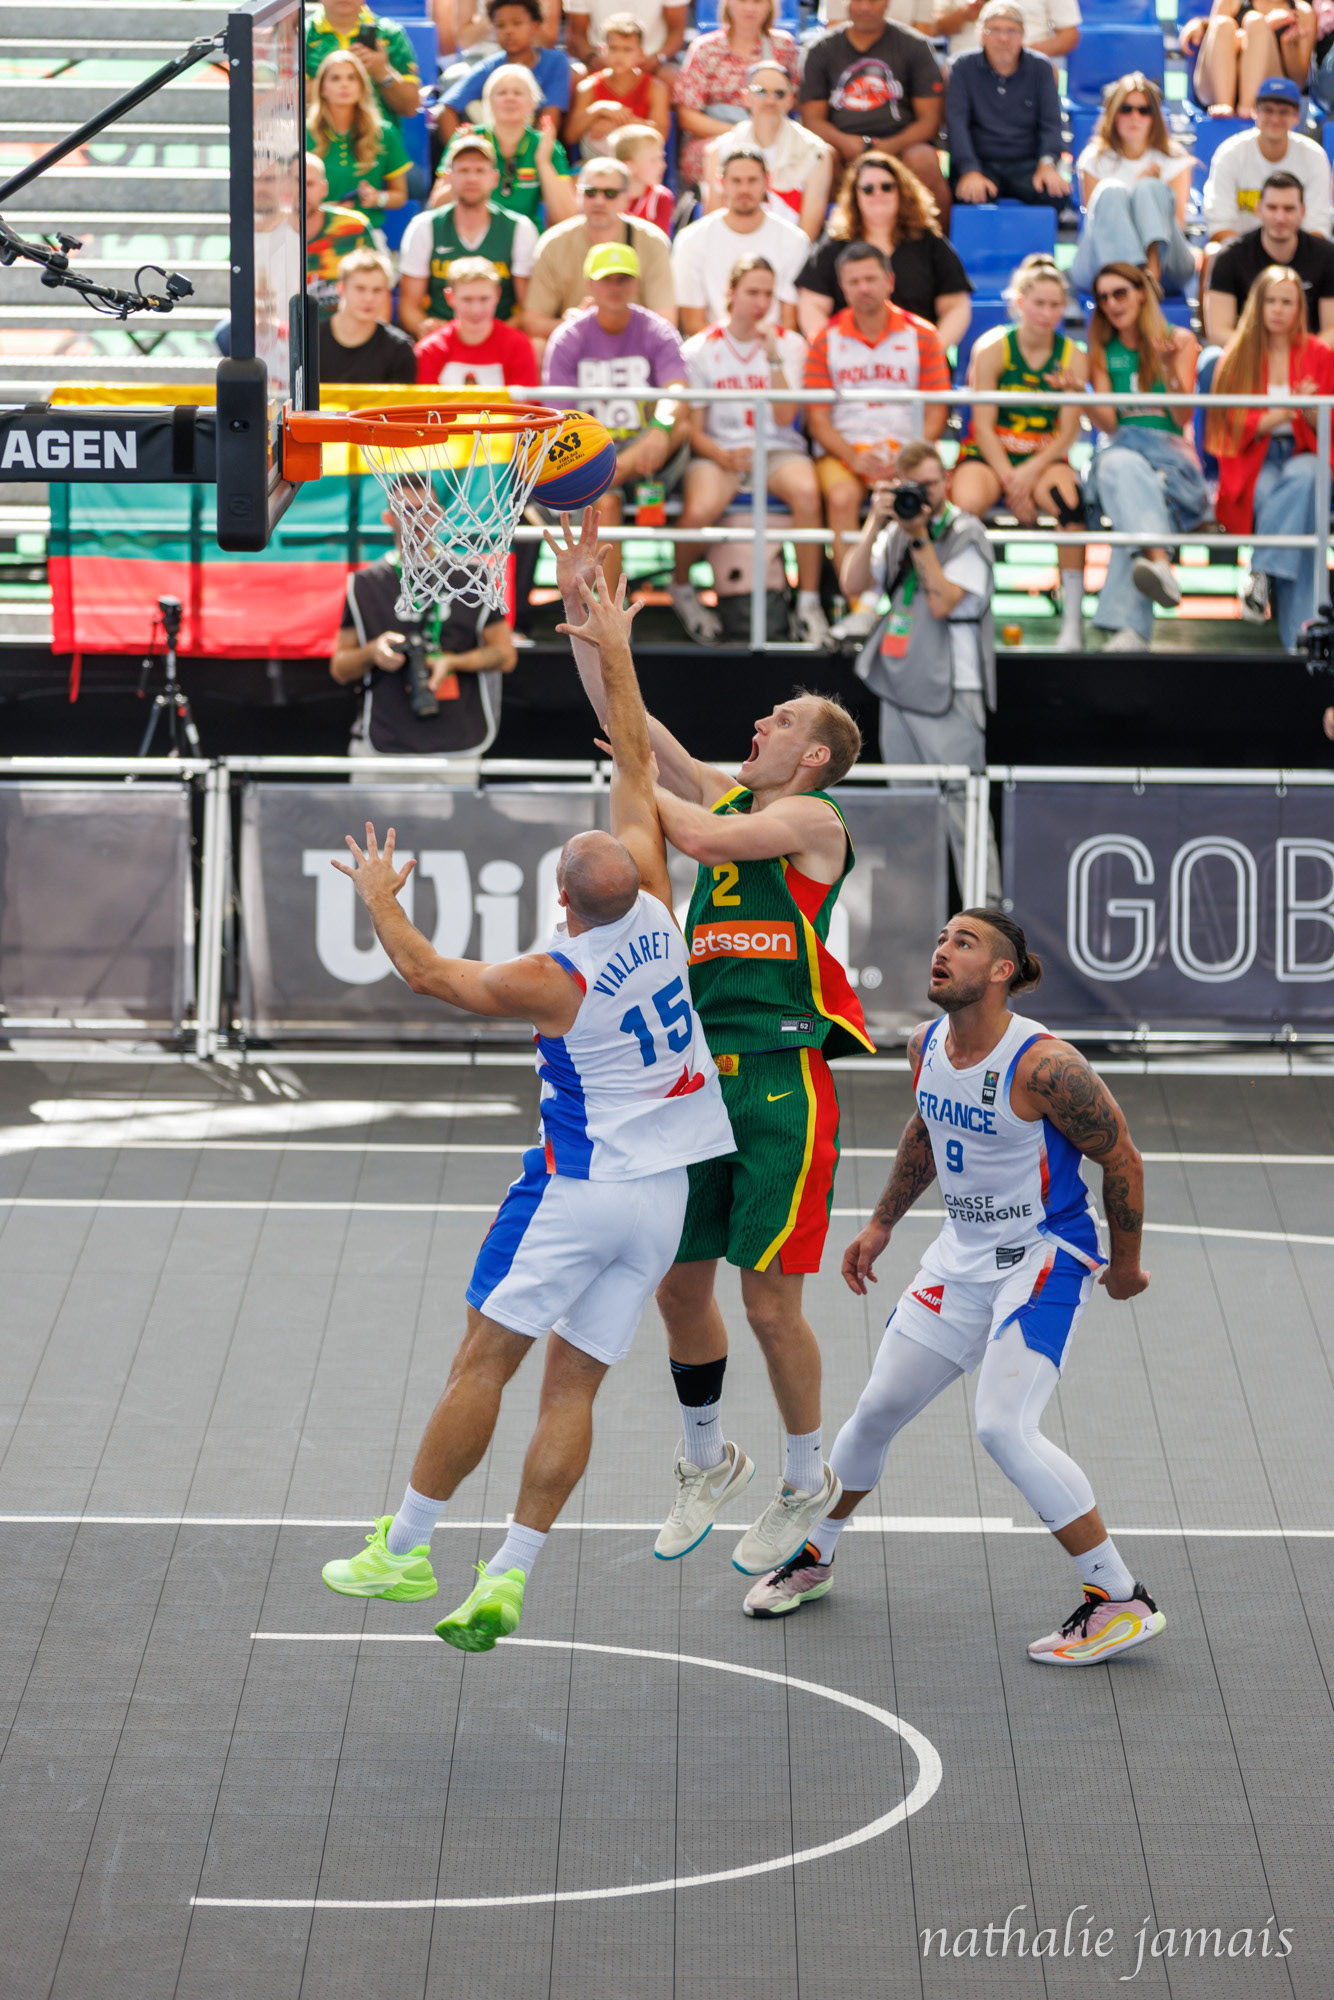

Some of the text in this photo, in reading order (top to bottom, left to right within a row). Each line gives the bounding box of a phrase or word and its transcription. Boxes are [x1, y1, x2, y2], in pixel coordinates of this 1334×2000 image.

[1, 430, 137, 469] AGEN
[712, 861, 741, 907] 2
[1067, 833, 1334, 983] GOB
[692, 931, 791, 956] etsson
[593, 932, 670, 997] VIALARET
[620, 975, 693, 1067] 15
[800, 1022, 809, 1030] 52
[919, 1091, 997, 1135] FRANCE
[946, 1139, 964, 1173] 9
[945, 1194, 994, 1209] CAISSE
[949, 1203, 1032, 1223] D'EPARGNE
[916, 1289, 943, 1306] MAIF
